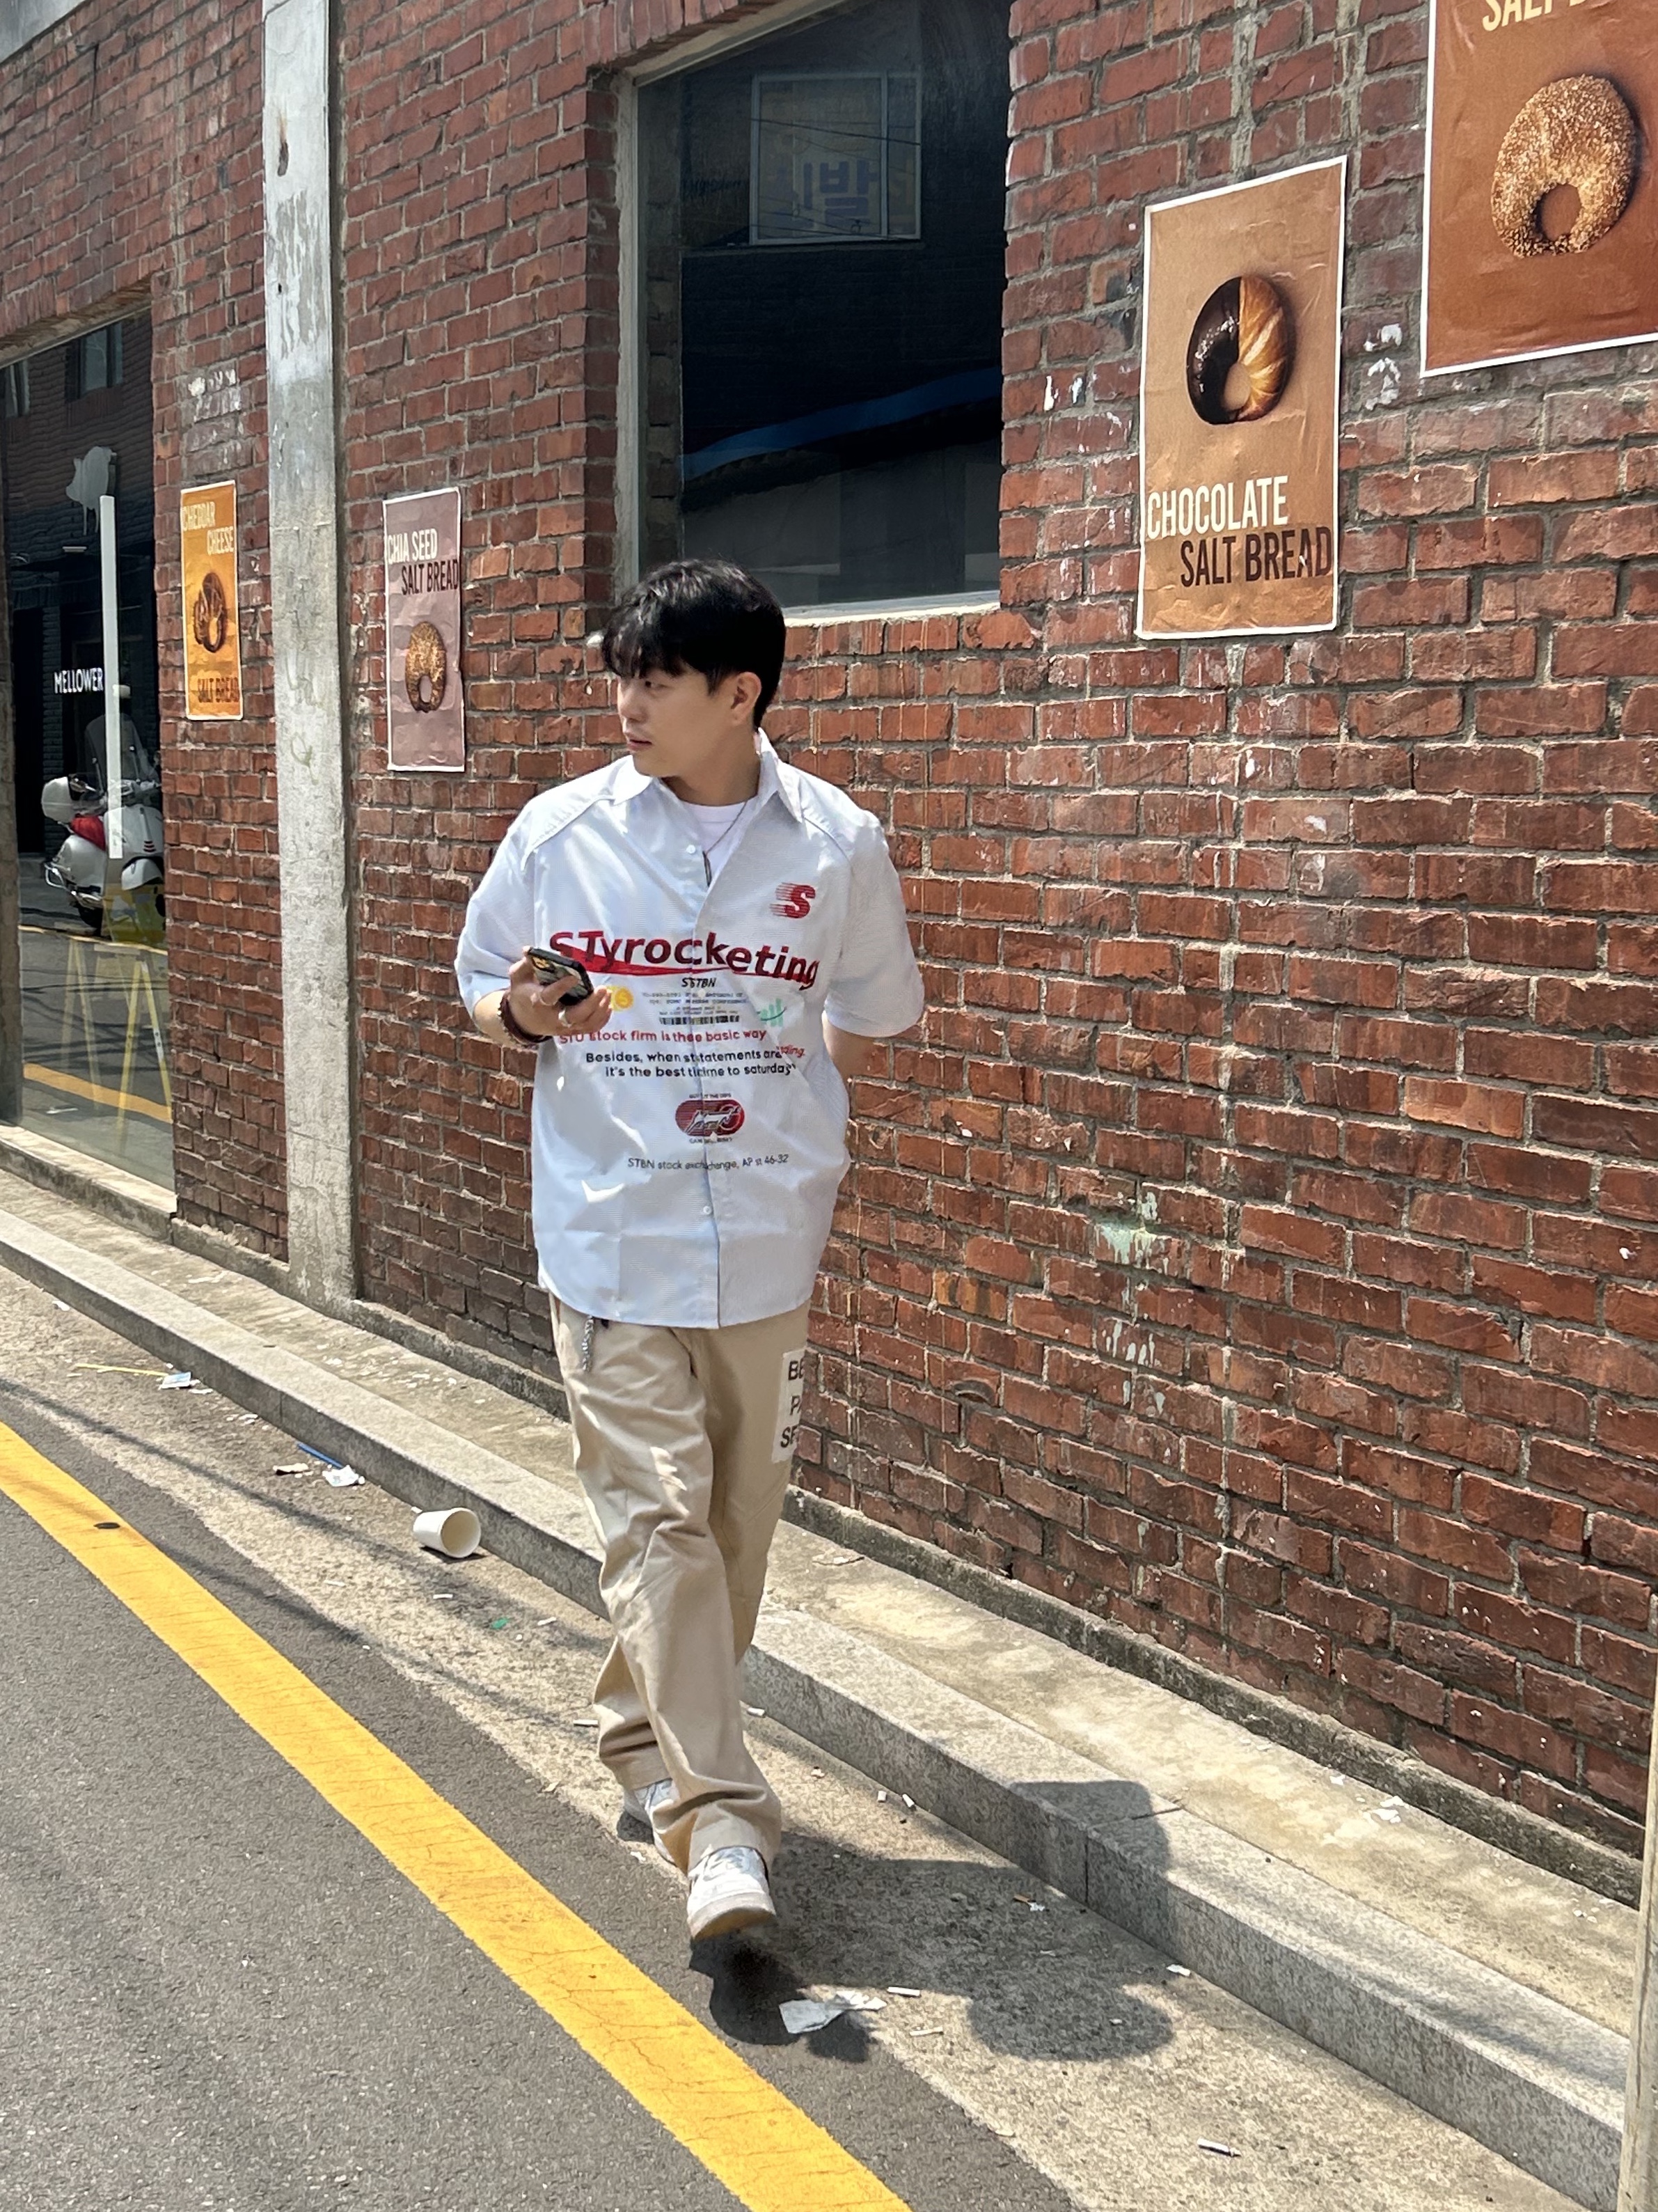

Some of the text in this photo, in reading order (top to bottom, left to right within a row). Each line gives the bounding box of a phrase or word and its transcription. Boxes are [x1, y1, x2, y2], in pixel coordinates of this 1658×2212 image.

[182, 501, 216, 532] CHEDDAR
[1148, 475, 1288, 540] CHOCOLATE
[207, 526, 234, 556] CHEESE
[387, 528, 438, 565] CHIA SEED
[1180, 526, 1332, 588] SALT BREAD
[401, 558, 459, 596] SALT BREAD
[54, 667, 104, 695] MELLOWER
[768, 881, 816, 919] S
[549, 930, 820, 991] STyrocketing
[631, 1030, 657, 1042] firm
[706, 1029, 741, 1042] basic
[743, 1029, 767, 1042] way
[585, 1050, 643, 1063] Besides,
[647, 1051, 681, 1062] when
[629, 1066, 652, 1077] the
[655, 1065, 686, 1077] best
[727, 1065, 741, 1076] to
[627, 1157, 655, 1169] STBN
[657, 1158, 683, 1170] stock
[789, 1395, 801, 1415] P
